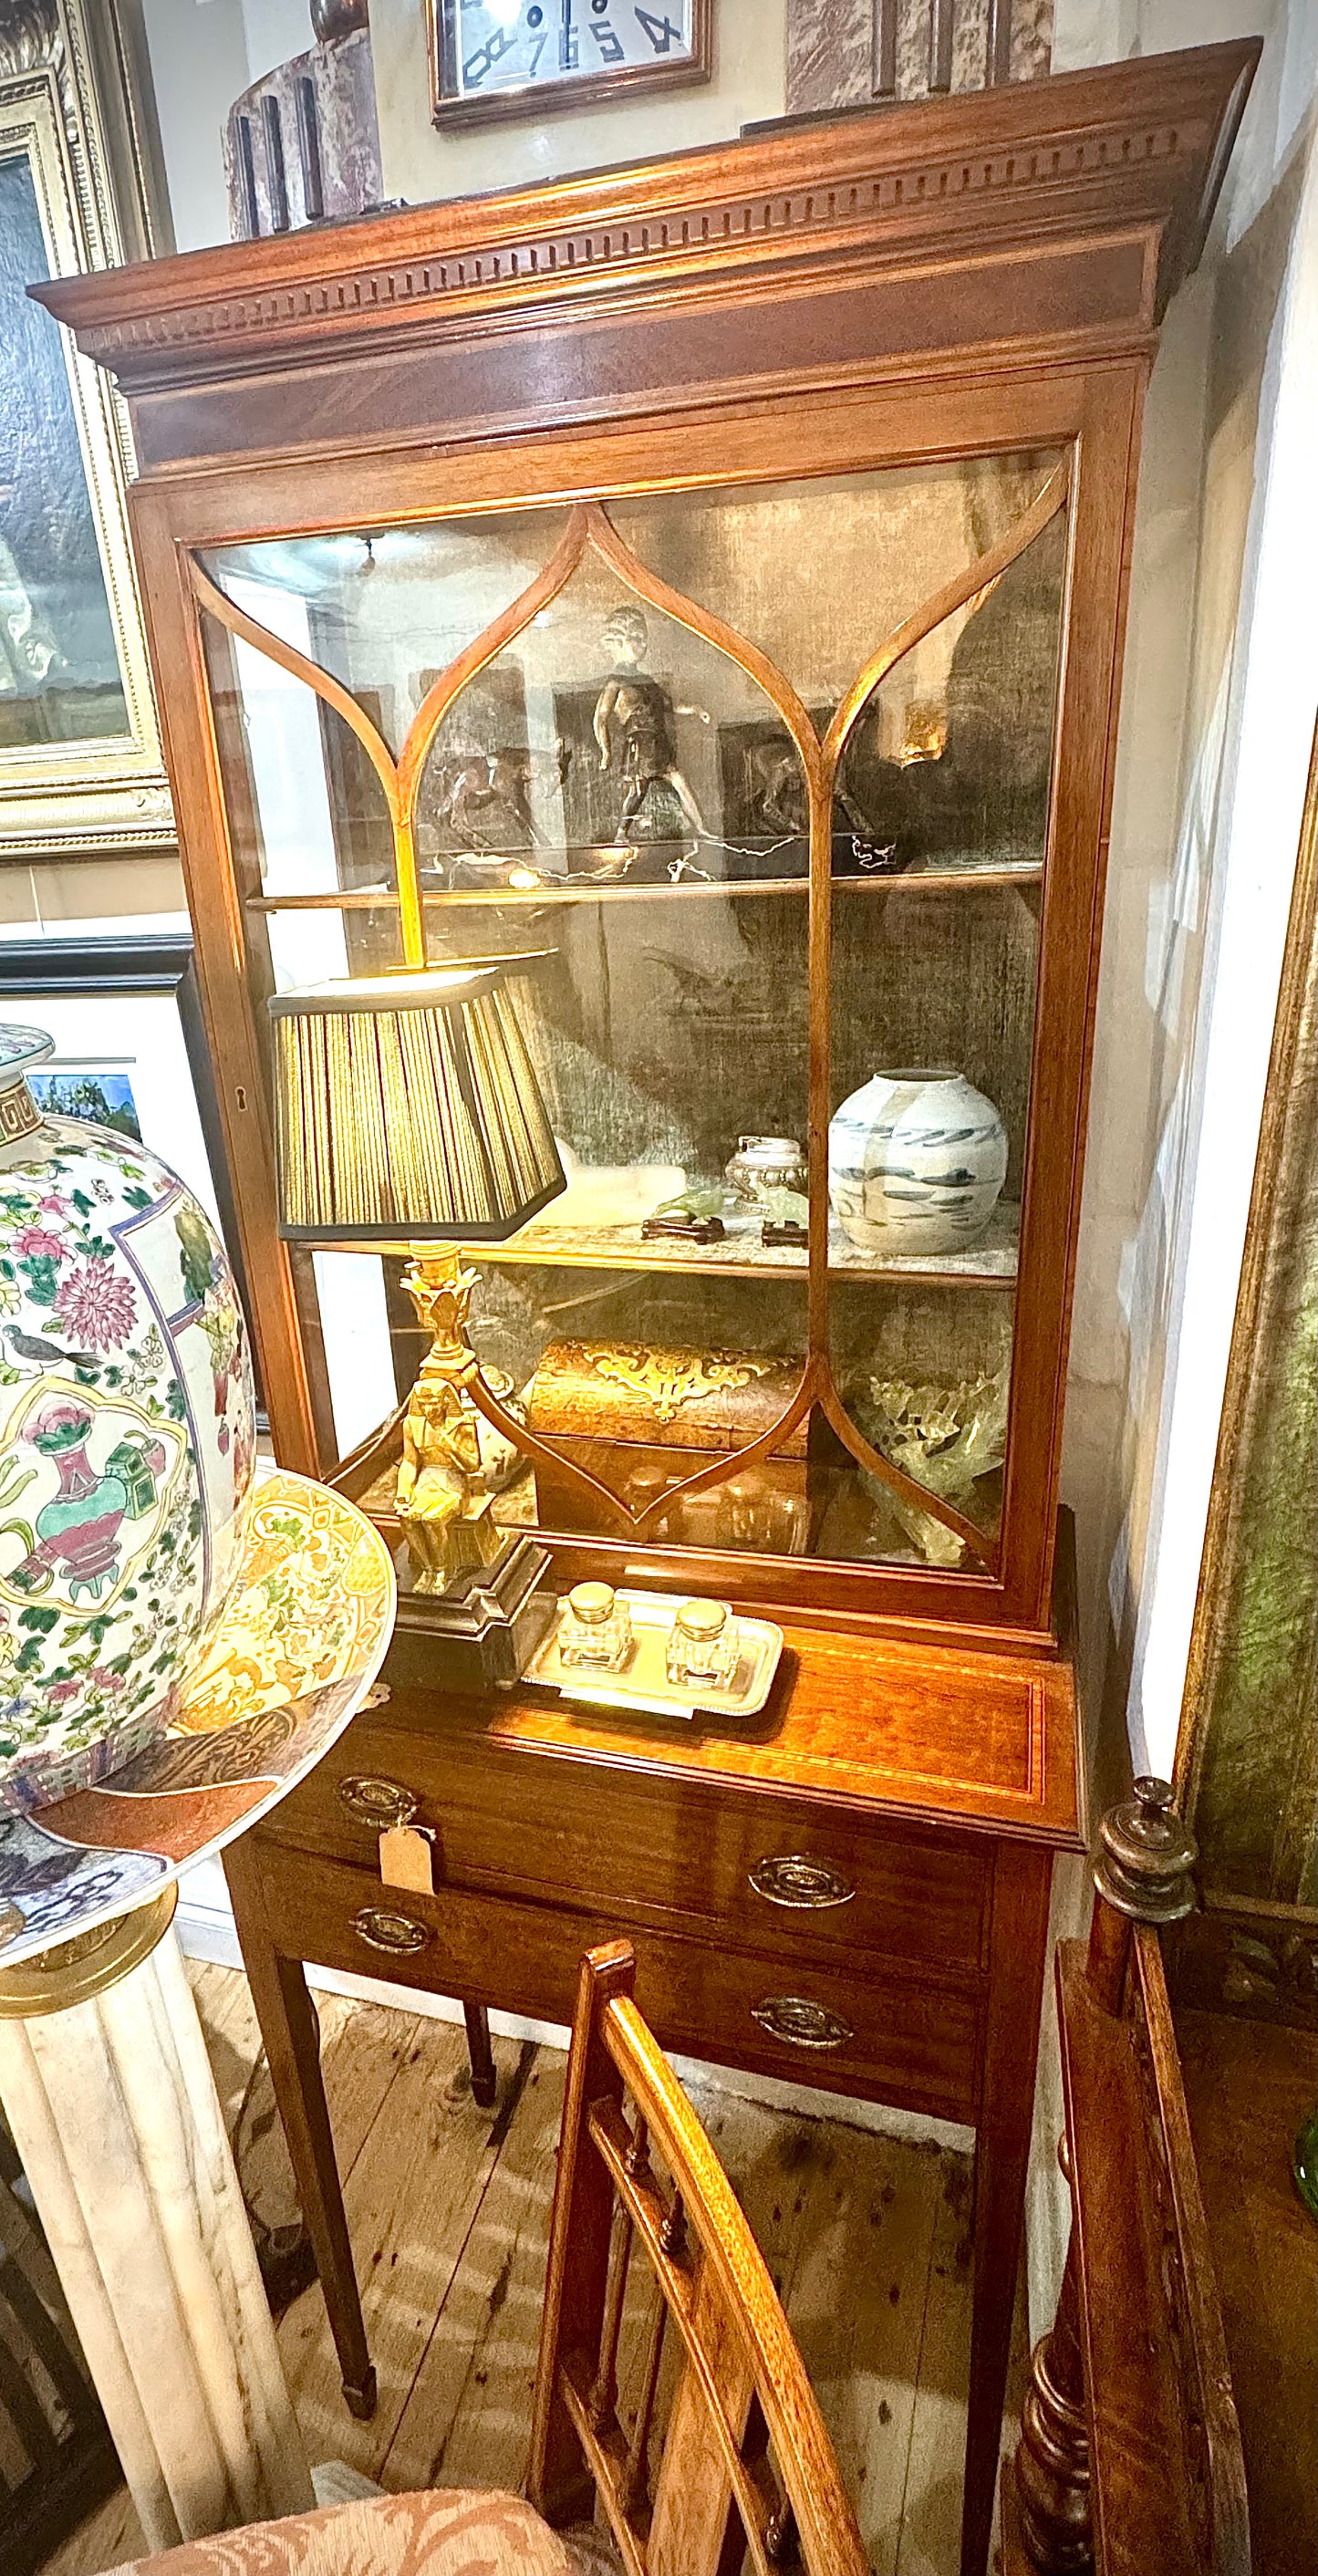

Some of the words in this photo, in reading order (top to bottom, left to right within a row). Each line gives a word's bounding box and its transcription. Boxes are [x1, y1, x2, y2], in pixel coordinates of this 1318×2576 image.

[558, 26, 579, 71] 6
[588, 21, 625, 63] 5
[634, 5, 681, 54] 4
[462, 27, 517, 88] 8
[529, 33, 547, 78] 7
